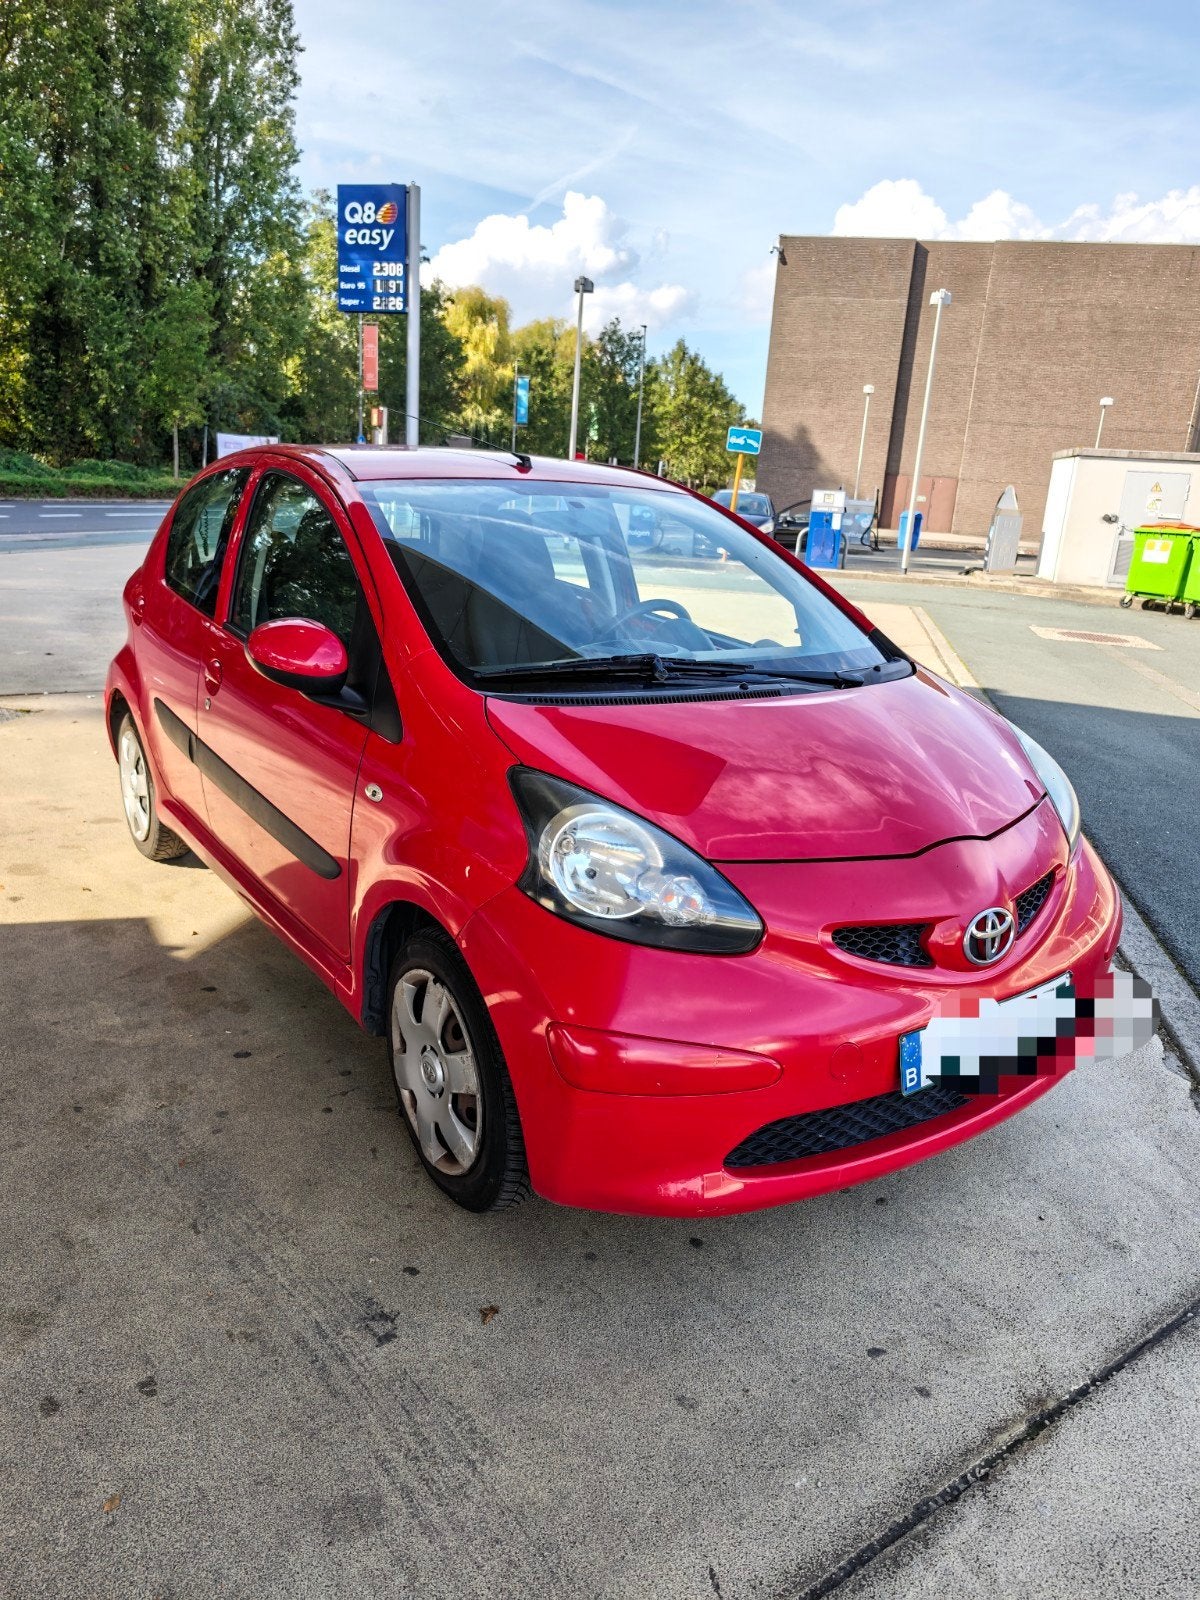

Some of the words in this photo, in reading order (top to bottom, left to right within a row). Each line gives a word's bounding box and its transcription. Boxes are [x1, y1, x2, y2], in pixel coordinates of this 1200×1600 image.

[344, 202, 376, 224] Q8
[344, 228, 395, 251] easy
[340, 264, 361, 273] Diesel
[340, 281, 356, 290] Euro
[356, 281, 366, 290] 95
[340, 297, 360, 307] Super
[905, 1067, 918, 1088] B
